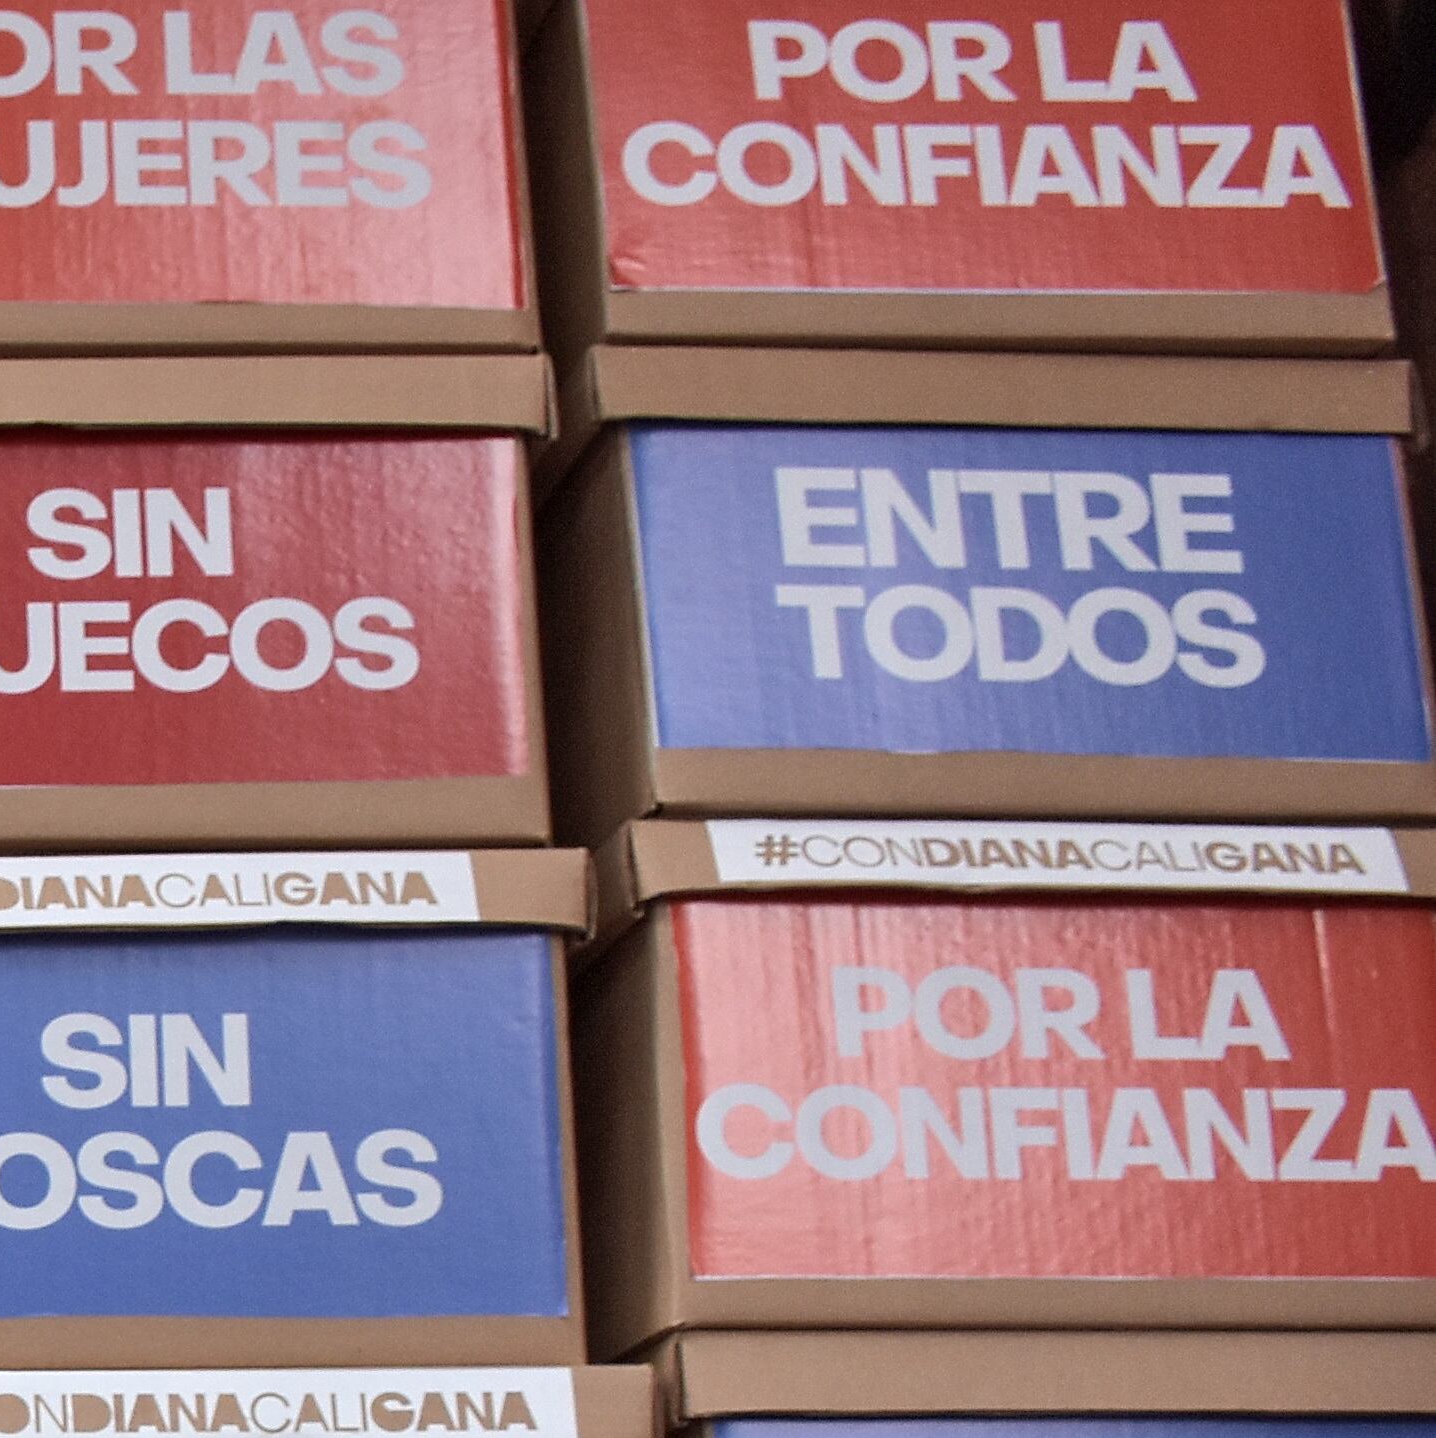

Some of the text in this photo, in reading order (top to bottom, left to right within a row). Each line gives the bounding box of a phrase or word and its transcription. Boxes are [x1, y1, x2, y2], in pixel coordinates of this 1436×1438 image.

[164, 10, 407, 97] LAS
[749, 21, 1196, 101] POR LA
[623, 122, 1348, 206] CONFIANZA
[27, 488, 233, 579] SIN
[775, 466, 1242, 572] ENTRE
[775, 583, 1264, 687] TODOS
[755, 834, 1366, 875] #CONDIANACALIGANA
[830, 966, 1289, 1062] POR LA
[42, 1013, 251, 1109] SIN
[697, 1080, 1436, 1184] CONFIANZA
